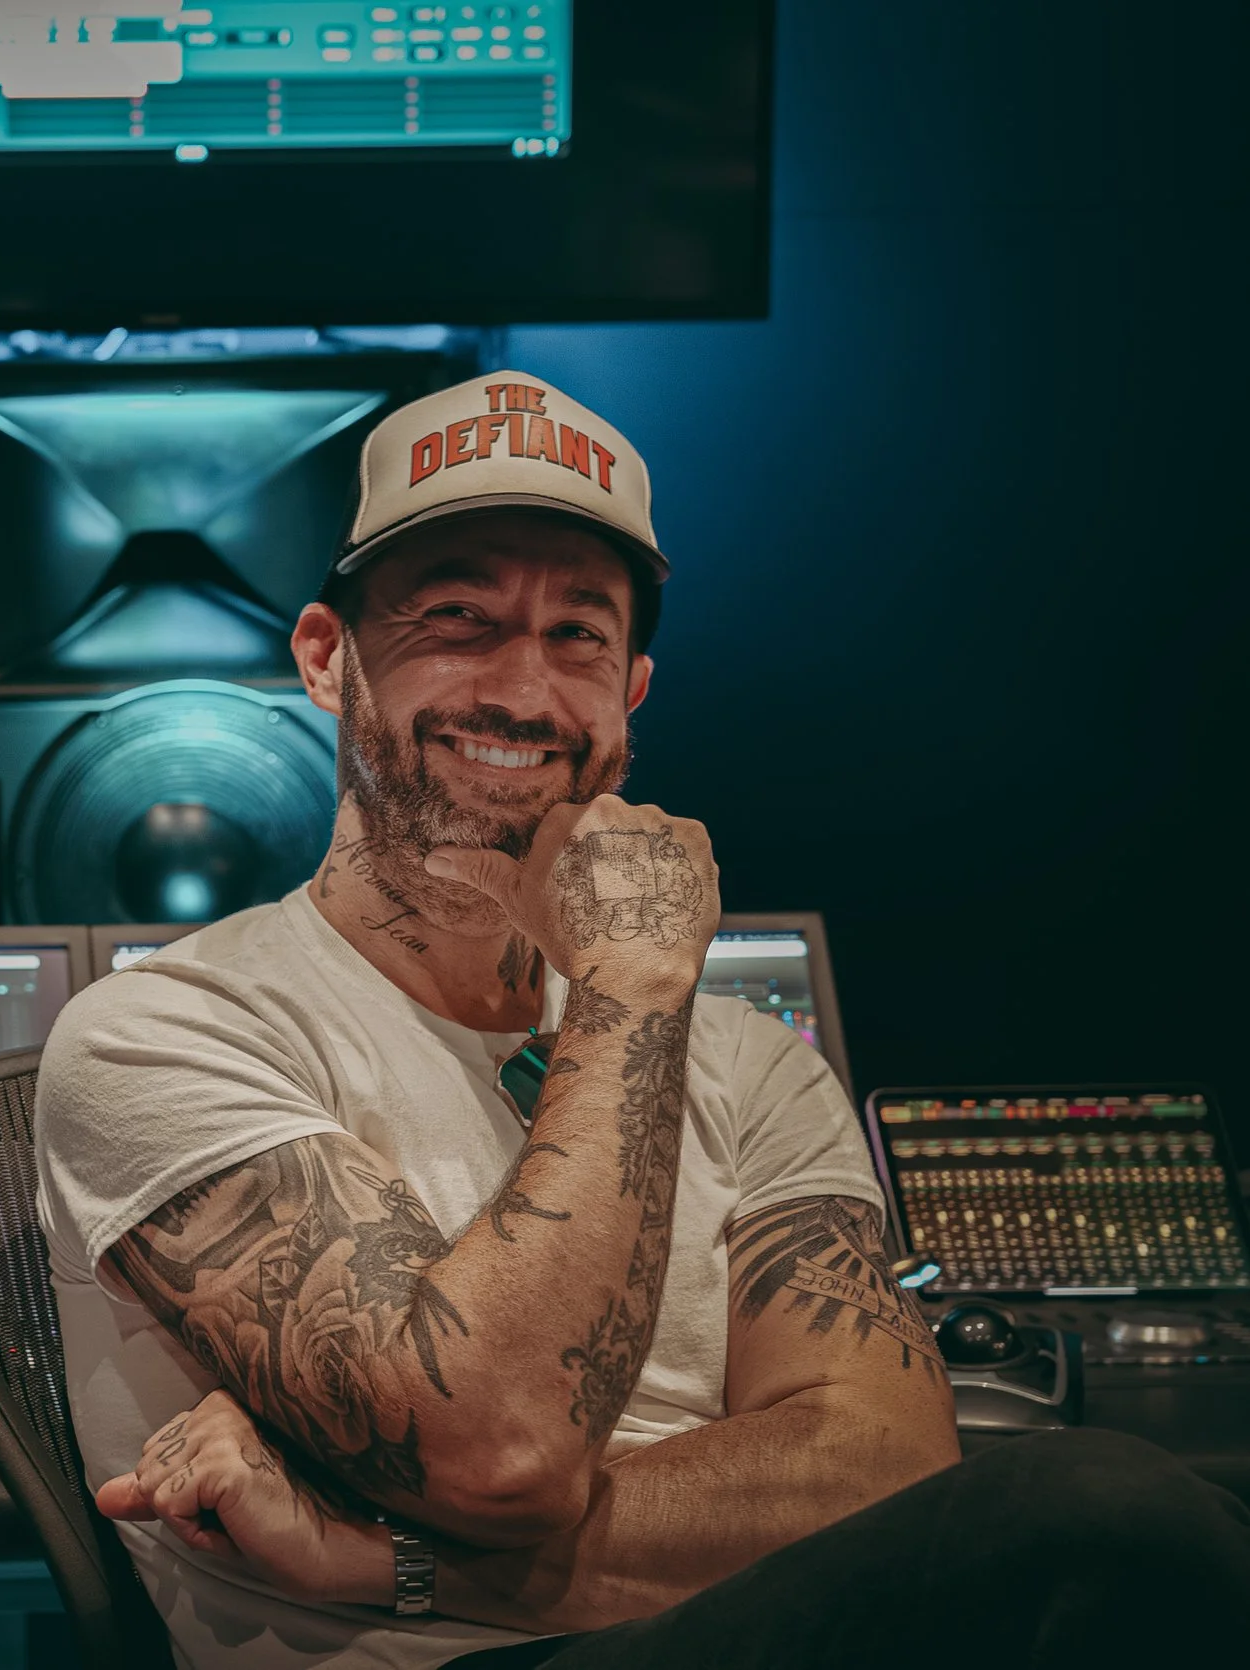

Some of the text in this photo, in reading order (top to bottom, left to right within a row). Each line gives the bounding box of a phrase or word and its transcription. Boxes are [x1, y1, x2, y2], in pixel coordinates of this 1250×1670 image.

[485, 384, 547, 416] THE
[409, 413, 616, 495] DEFIANT
[360, 904, 430, 954] Jean
[801, 1268, 865, 1301] JOHN
